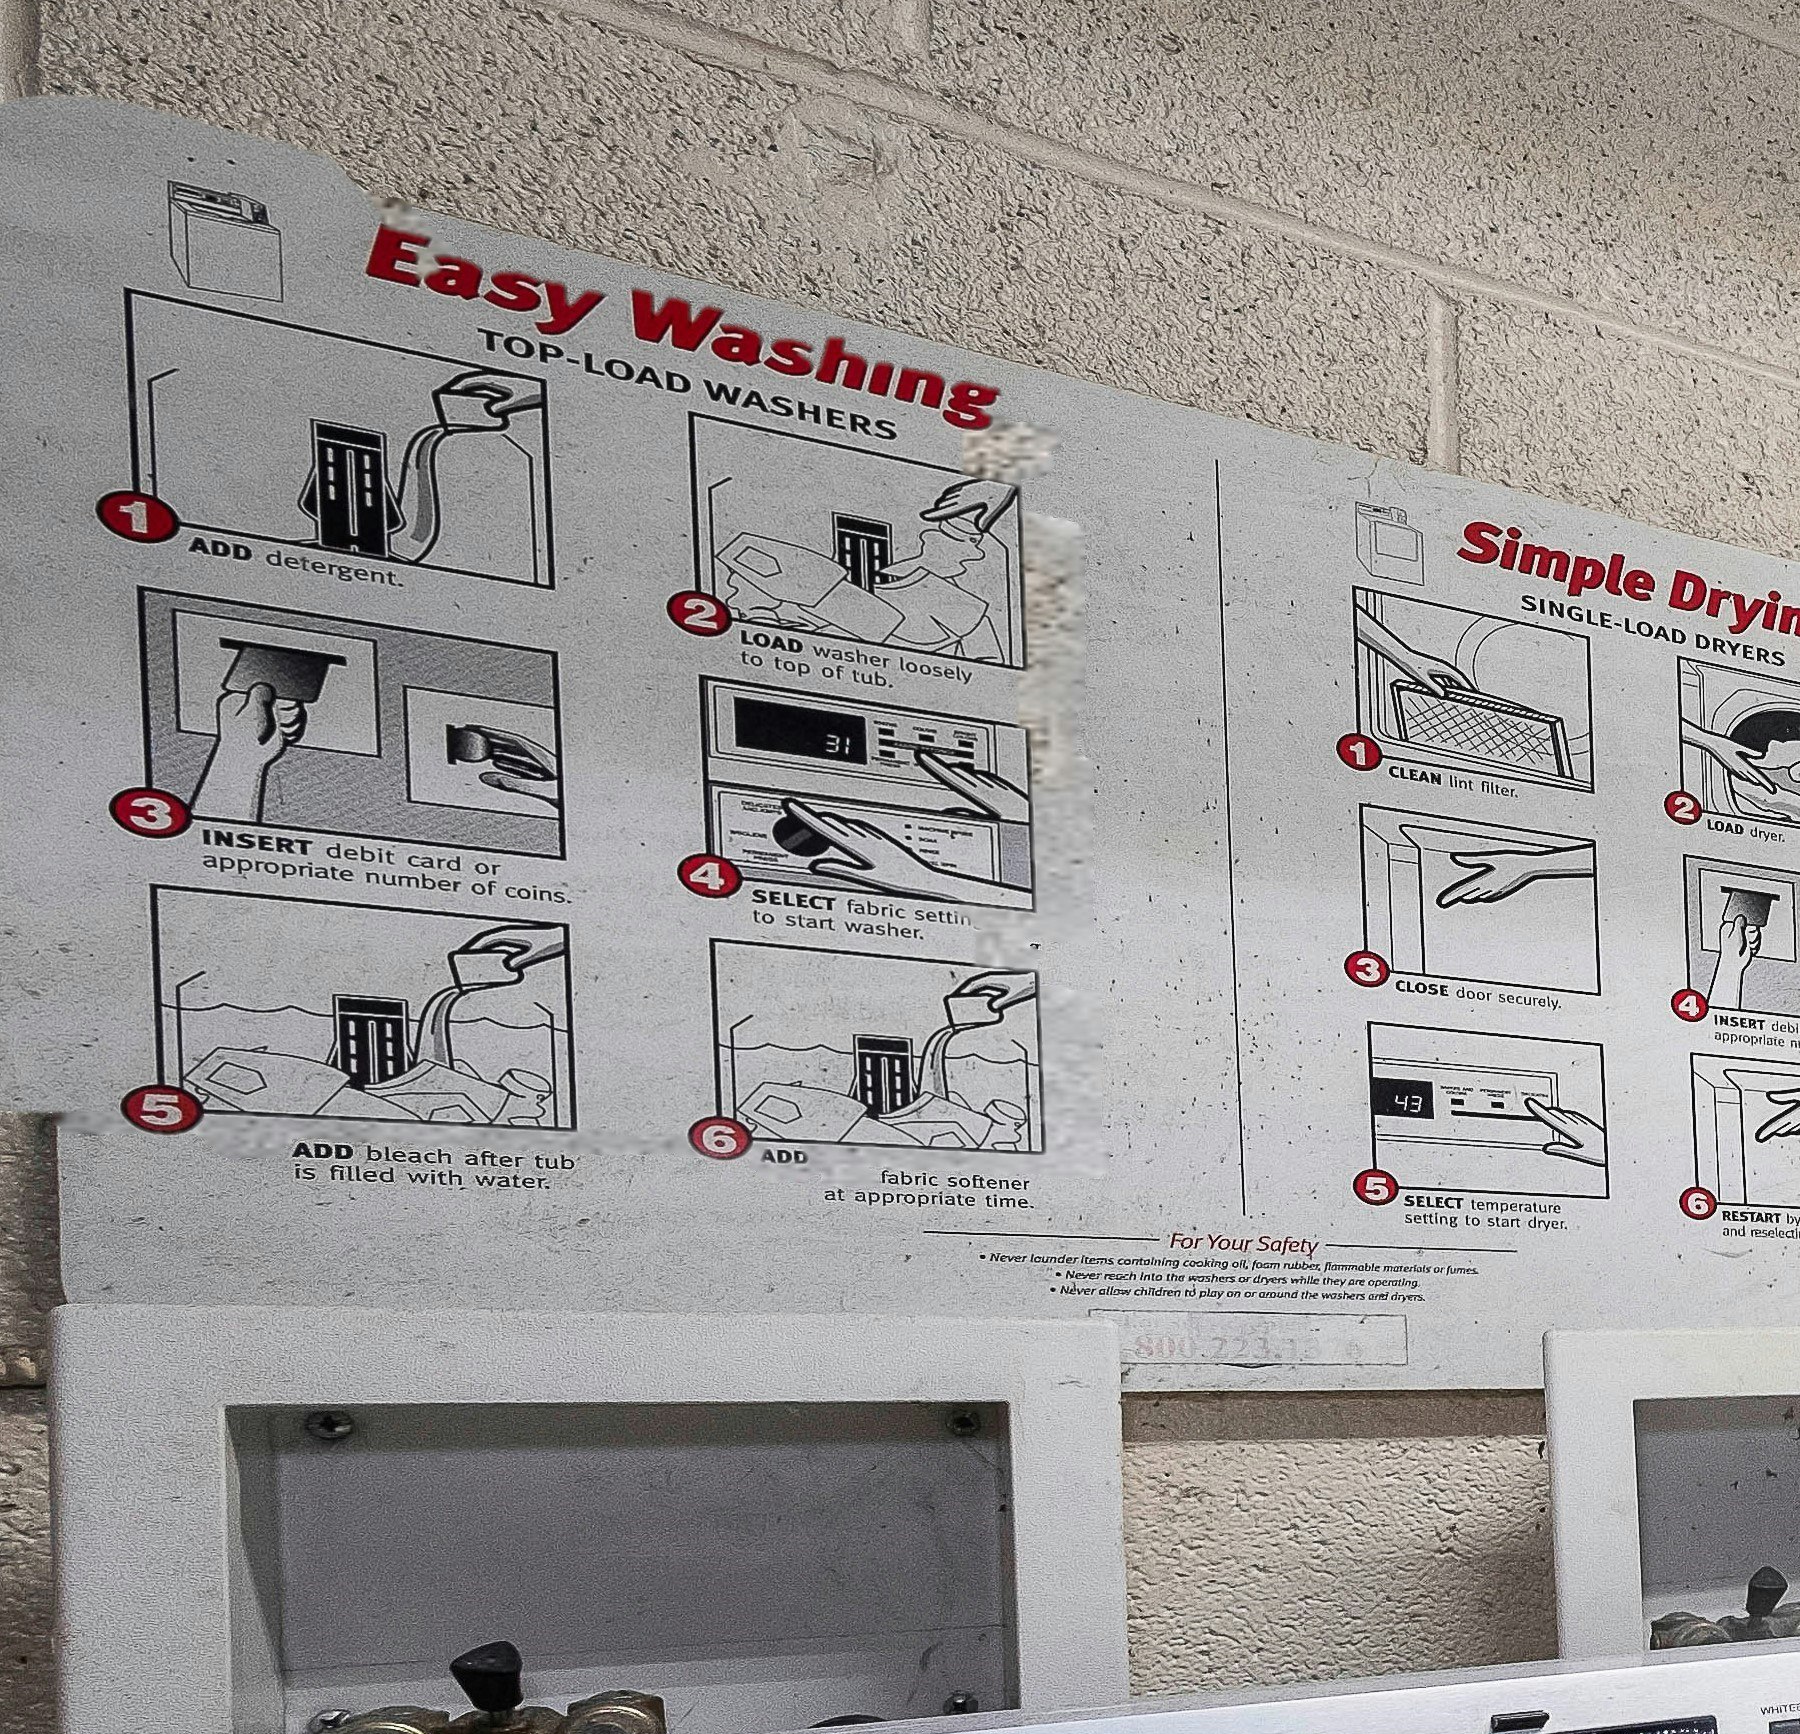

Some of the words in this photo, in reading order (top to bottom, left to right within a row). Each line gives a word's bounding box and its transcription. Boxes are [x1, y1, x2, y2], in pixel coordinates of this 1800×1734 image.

[365, 224, 606, 335] Easy
[632, 289, 1001, 430] Washing
[477, 327, 691, 393] TOP-LOAD
[703, 379, 898, 440] WASHERS
[119, 501, 148, 533] 1
[188, 537, 252, 561] ADD
[265, 550, 404, 587] detergent.
[1456, 521, 1655, 600] Simple
[684, 599, 718, 629] 2
[1520, 594, 1686, 646] SINGLE-LOAD
[1695, 634, 1786, 667] DRYERS
[740, 630, 803, 653] LOAD
[813, 645, 890, 668] washer
[900, 656, 972, 684] loosely
[741, 651, 763, 667] to
[775, 656, 810, 677] top
[821, 662, 845, 680] of
[852, 668, 893, 688] tub.
[825, 734, 850, 755] 31
[1349, 743, 1369, 765] 1
[1388, 766, 1442, 786] CLEAN
[1448, 774, 1474, 791] lint
[1481, 780, 1519, 799] filter.
[130, 797, 172, 830] 3
[1674, 797, 1695, 818] 2
[1707, 818, 1744, 835] LOAD
[1749, 825, 1785, 845] dryer.
[202, 829, 313, 856] INSERT
[326, 842, 396, 865] debit
[407, 851, 461, 873] card
[475, 861, 500, 876] or
[202, 854, 354, 884] appropriate
[365, 871, 461, 893] number
[471, 880, 497, 896] of
[505, 885, 573, 904] coins.
[689, 862, 725, 891] 4
[752, 889, 836, 911] SELECT
[847, 899, 906, 919] fabric
[914, 909, 981, 930] settin
[754, 909, 774, 924] to
[785, 914, 835, 931] start
[845, 921, 924, 941] washer.
[1356, 958, 1379, 981] 3
[1395, 979, 1449, 997] CLOSE
[1456, 985, 1492, 1001] door
[1498, 991, 1562, 1011] securely.
[1678, 995, 1701, 1017] 4
[1714, 1014, 1765, 1031] INSERT
[1714, 1031, 1785, 1047] appropriate
[140, 1093, 184, 1125] 5
[1394, 1095, 1422, 1112] 43
[701, 1124, 737, 1153] 6
[291, 1142, 354, 1160] ADD
[366, 1146, 452, 1165] bleach
[464, 1150, 525, 1170] after
[534, 1152, 575, 1171] tub
[760, 1149, 808, 1165] ADD
[294, 1162, 316, 1180] is
[330, 1163, 394, 1184] filled
[406, 1168, 463, 1187] with
[474, 1173, 551, 1190] water.
[880, 1170, 938, 1187] fabric
[947, 1174, 1031, 1191] softener
[1364, 1177, 1388, 1199] 5
[824, 1188, 845, 1202] at
[854, 1190, 976, 1208] appropriate
[985, 1193, 1035, 1209] time.
[1404, 1195, 1463, 1209] SELECT
[1470, 1199, 1562, 1215] temperature
[1687, 1194, 1707, 1213] 6
[1404, 1213, 1459, 1229] setting
[1464, 1215, 1480, 1226] to
[1487, 1216, 1522, 1228] start
[1529, 1216, 1568, 1231] dryer.
[1722, 1210, 1781, 1224] RESTART
[1786, 1212, 1800, 1227] by
[1722, 1226, 1746, 1238] and
[1170, 1233, 1203, 1250] For
[1208, 1235, 1252, 1251] Your
[1256, 1236, 1319, 1255] Safety
[989, 1253, 1027, 1263] Never
[1030, 1254, 1078, 1265] launder
[1081, 1255, 1114, 1265] items
[1117, 1256, 1180, 1269] containing
[1183, 1258, 1228, 1270] cooking
[1251, 1260, 1280, 1271] foam
[1283, 1261, 1320, 1272] rubber,
[1324, 1261, 1380, 1273] flammable
[1383, 1263, 1431, 1274] materials
[1434, 1265, 1445, 1274] or
[1445, 1264, 1479, 1275] fumes.
[1065, 1270, 1100, 1280] Never
[1104, 1271, 1136, 1281] reach
[1140, 1272, 1163, 1281] into
[1166, 1272, 1185, 1282] the
[1188, 1273, 1236, 1284] washers
[1238, 1275, 1251, 1284] or
[1253, 1275, 1287, 1286] dryers
[1290, 1275, 1320, 1286] while
[1322, 1276, 1345, 1287] they
[1349, 1278, 1365, 1286] are
[1368, 1277, 1420, 1289] operating.
[1060, 1285, 1095, 1296] Never
[1099, 1286, 1131, 1296] allow
[1134, 1286, 1181, 1297] children
[1185, 1288, 1196, 1298] to
[1199, 1289, 1224, 1300] play
[1244, 1291, 1257, 1299] or
[1259, 1290, 1298, 1300] around
[1301, 1290, 1318, 1300] the
[1321, 1290, 1365, 1301] washers
[1368, 1291, 1388, 1301] and
[1390, 1292, 1426, 1303] dryers.
